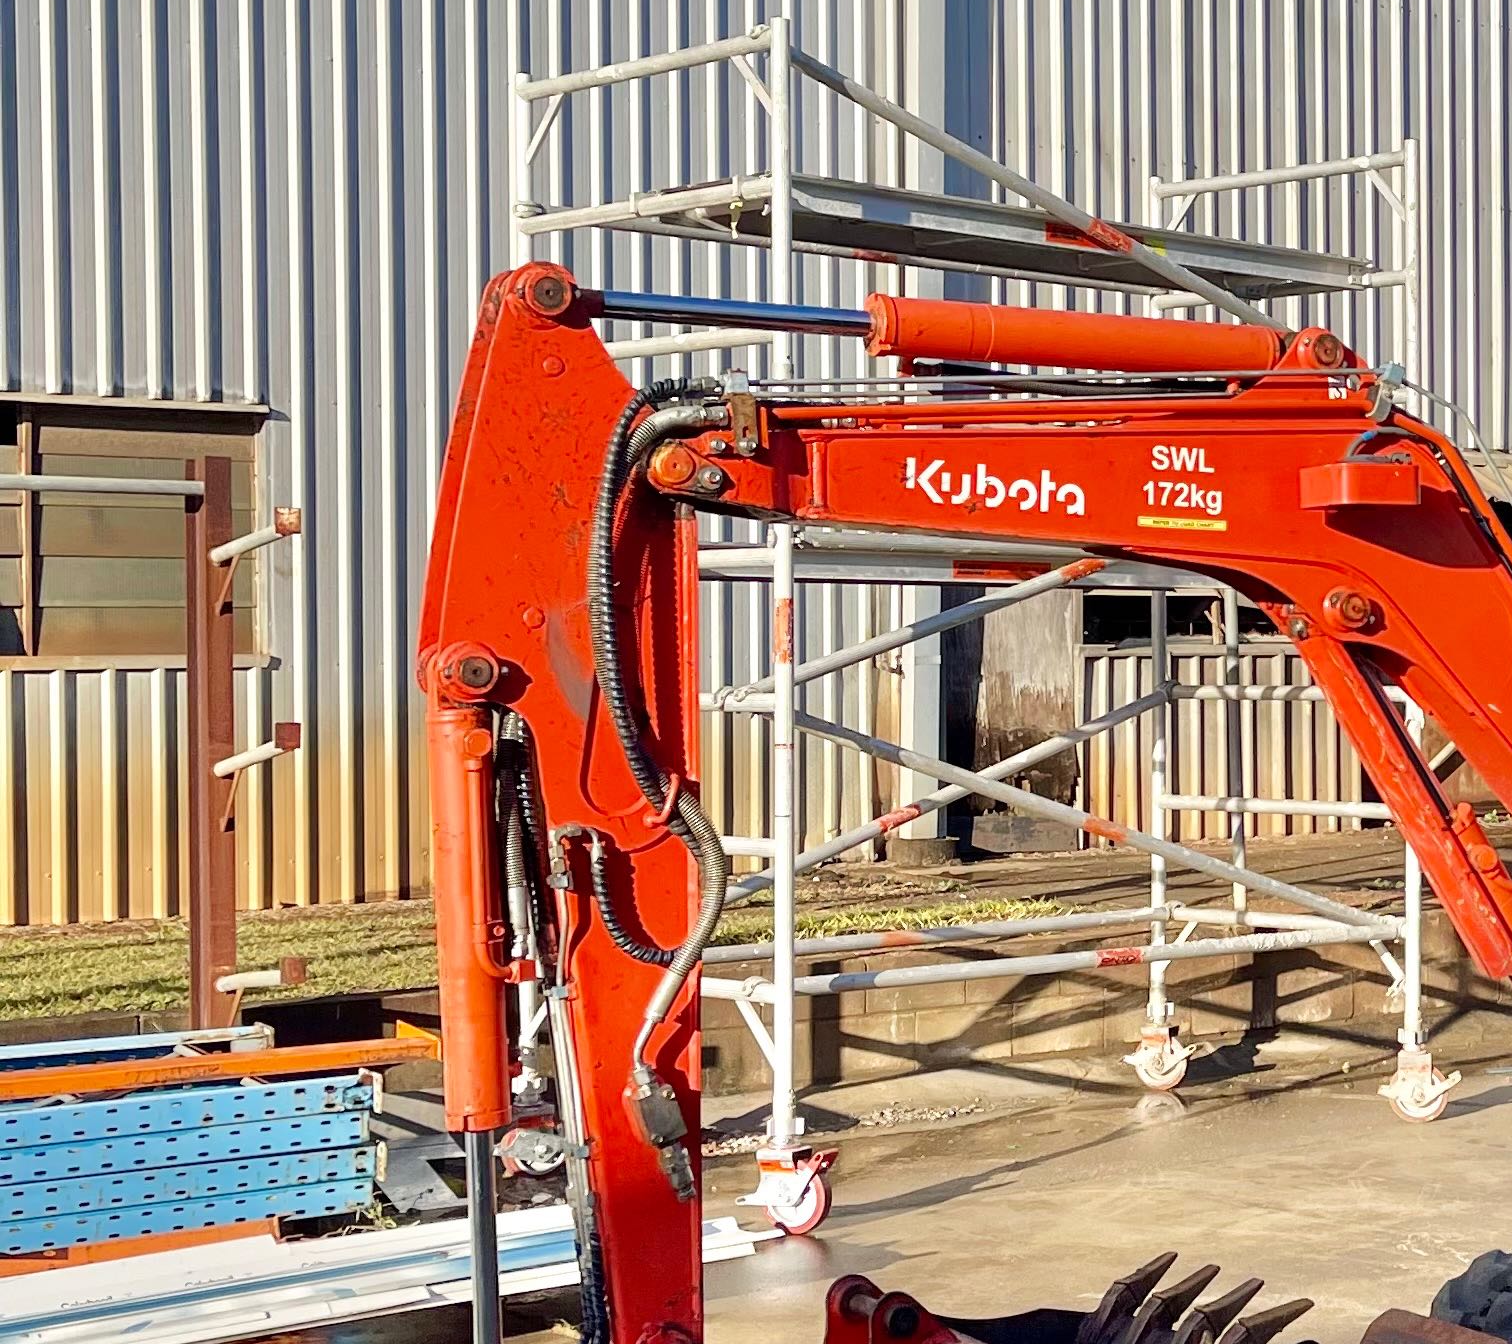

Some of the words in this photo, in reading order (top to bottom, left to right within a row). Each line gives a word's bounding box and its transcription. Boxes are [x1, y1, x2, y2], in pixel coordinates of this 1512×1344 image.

[1151, 445, 1215, 474] SWL
[905, 457, 1085, 516] Kubota
[1143, 481, 1223, 515] 172kg
